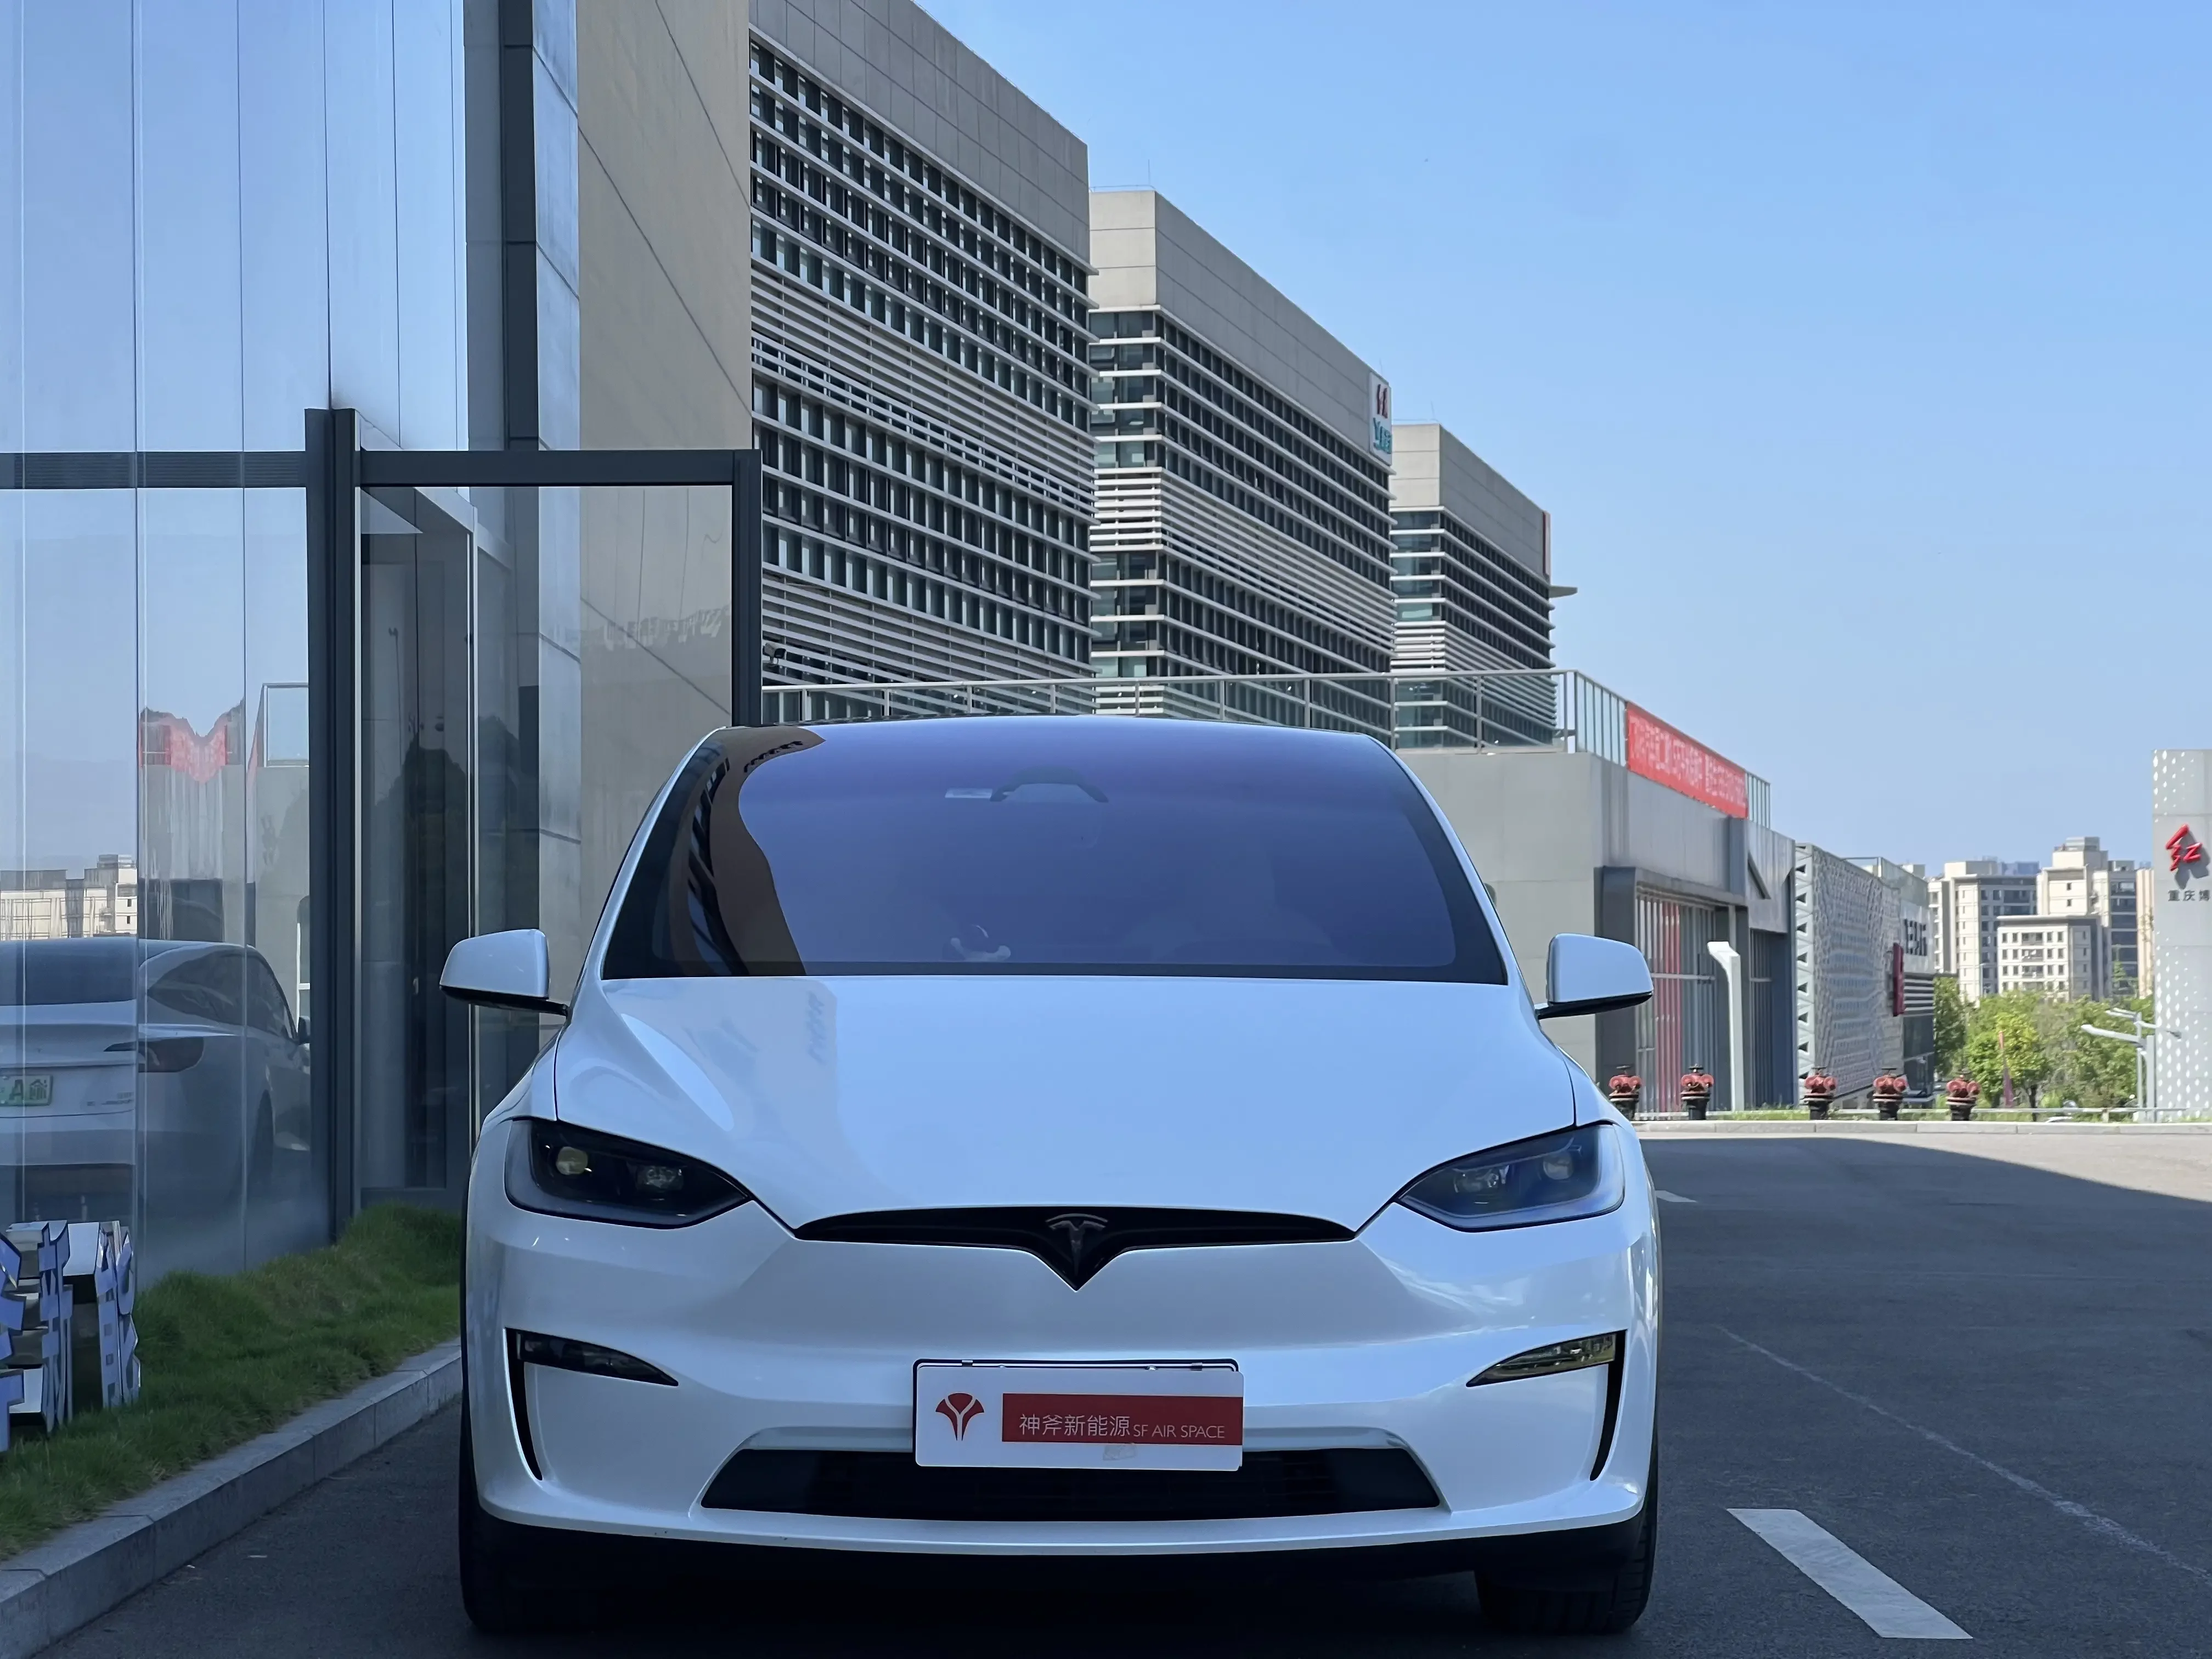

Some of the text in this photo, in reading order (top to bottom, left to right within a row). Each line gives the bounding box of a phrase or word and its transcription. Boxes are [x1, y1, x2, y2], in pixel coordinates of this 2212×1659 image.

[1019, 1413, 1225, 1438] 神斧新能源 SF AIR SPACE
